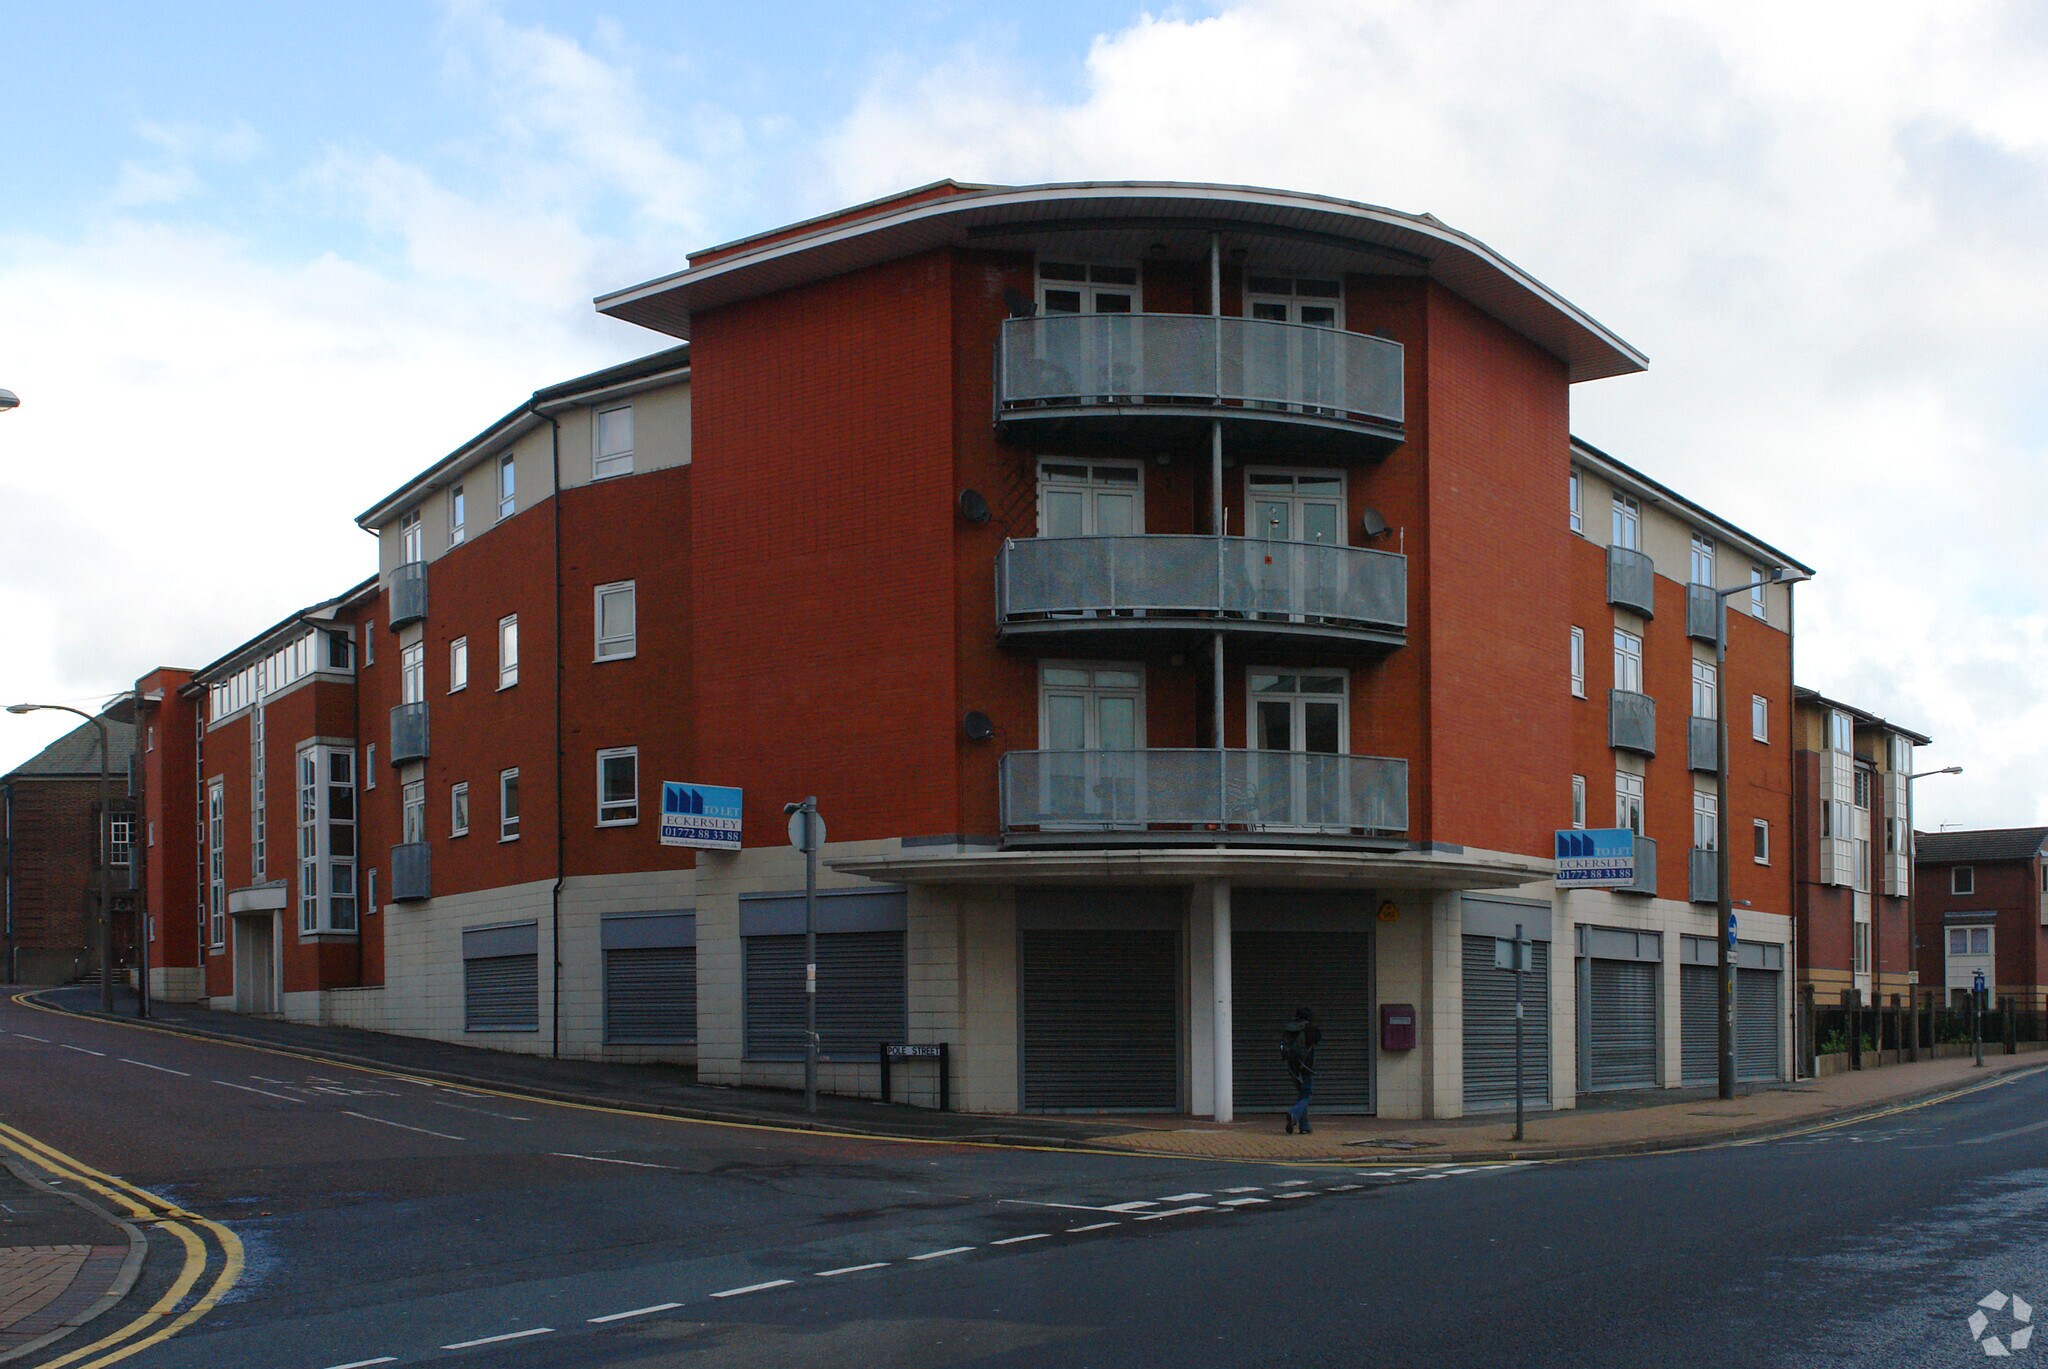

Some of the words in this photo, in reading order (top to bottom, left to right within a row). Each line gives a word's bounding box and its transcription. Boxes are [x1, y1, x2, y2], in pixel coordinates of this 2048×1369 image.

[704, 806, 718, 814] TO
[721, 807, 739, 816] LET
[666, 816, 738, 829] ECKERSLEY
[665, 827, 695, 837] 01772
[698, 830, 709, 839] 88
[713, 831, 724, 839] 33
[727, 832, 739, 841] 88
[1594, 847, 1609, 855] TO
[1612, 847, 1631, 855] LET
[1560, 858, 1630, 868] ECKERSLEY
[1559, 870, 1588, 879] 01772
[1591, 870, 1602, 879] 88
[1605, 869, 1616, 878] 33
[1619, 869, 1631, 878] 88
[888, 1046, 906, 1055] POLE
[912, 1046, 939, 1055] STREET
